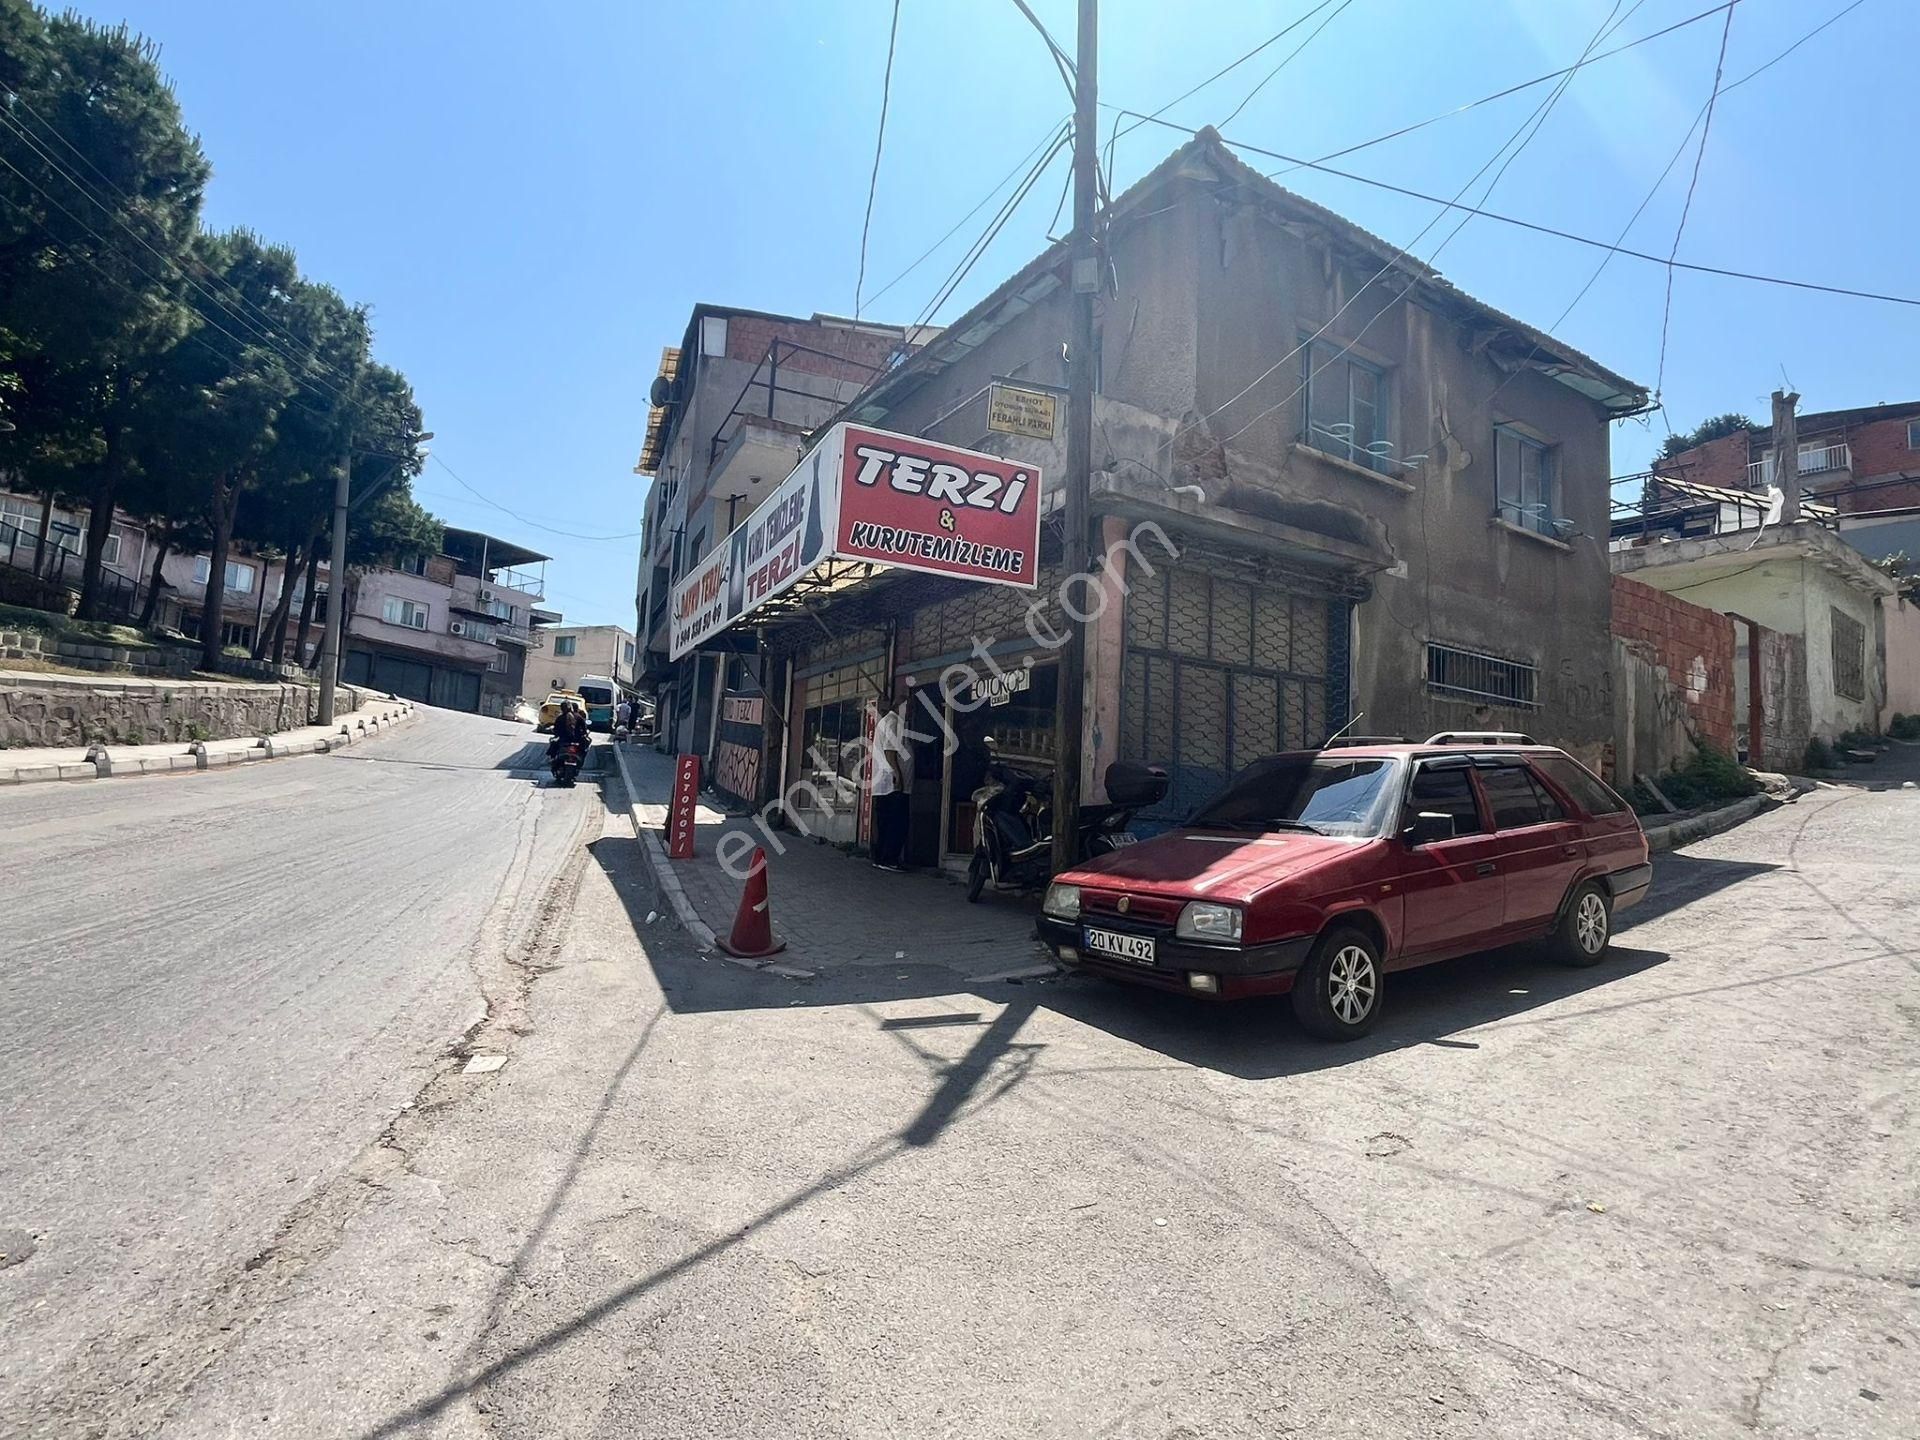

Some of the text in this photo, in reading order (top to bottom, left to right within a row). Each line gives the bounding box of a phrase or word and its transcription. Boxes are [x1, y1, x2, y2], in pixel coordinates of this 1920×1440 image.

[856, 446, 1028, 514] TERZİ
[940, 509, 956, 531] &
[850, 520, 1024, 574] KURUTEMİZLEME
[1090, 931, 1152, 960] 20 KV 492
